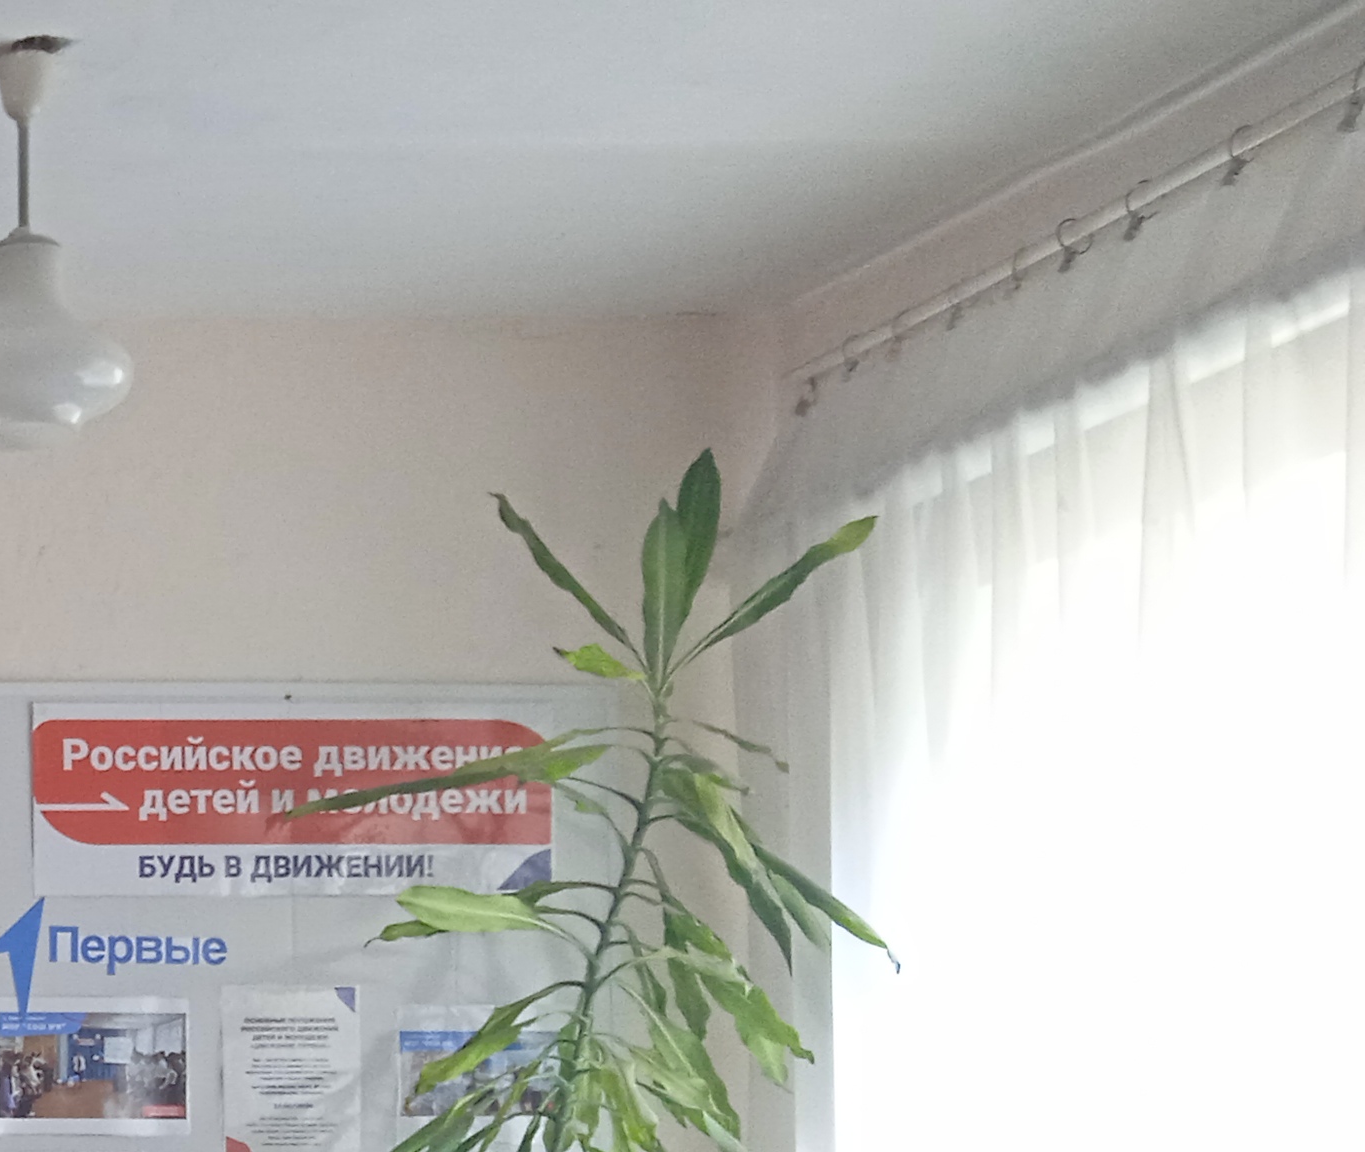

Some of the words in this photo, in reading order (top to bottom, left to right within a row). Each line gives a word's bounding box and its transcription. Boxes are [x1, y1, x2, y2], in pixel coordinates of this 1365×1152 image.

[62, 736, 302, 772] Российское
[313, 743, 523, 777] движени
[138, 779, 260, 821] детей
[271, 787, 294, 814] и
[138, 854, 215, 880] БУДЬ
[224, 855, 242, 878] В
[250, 854, 435, 881] ДВИЖЕНИИ!
[49, 925, 228, 976] Первые
